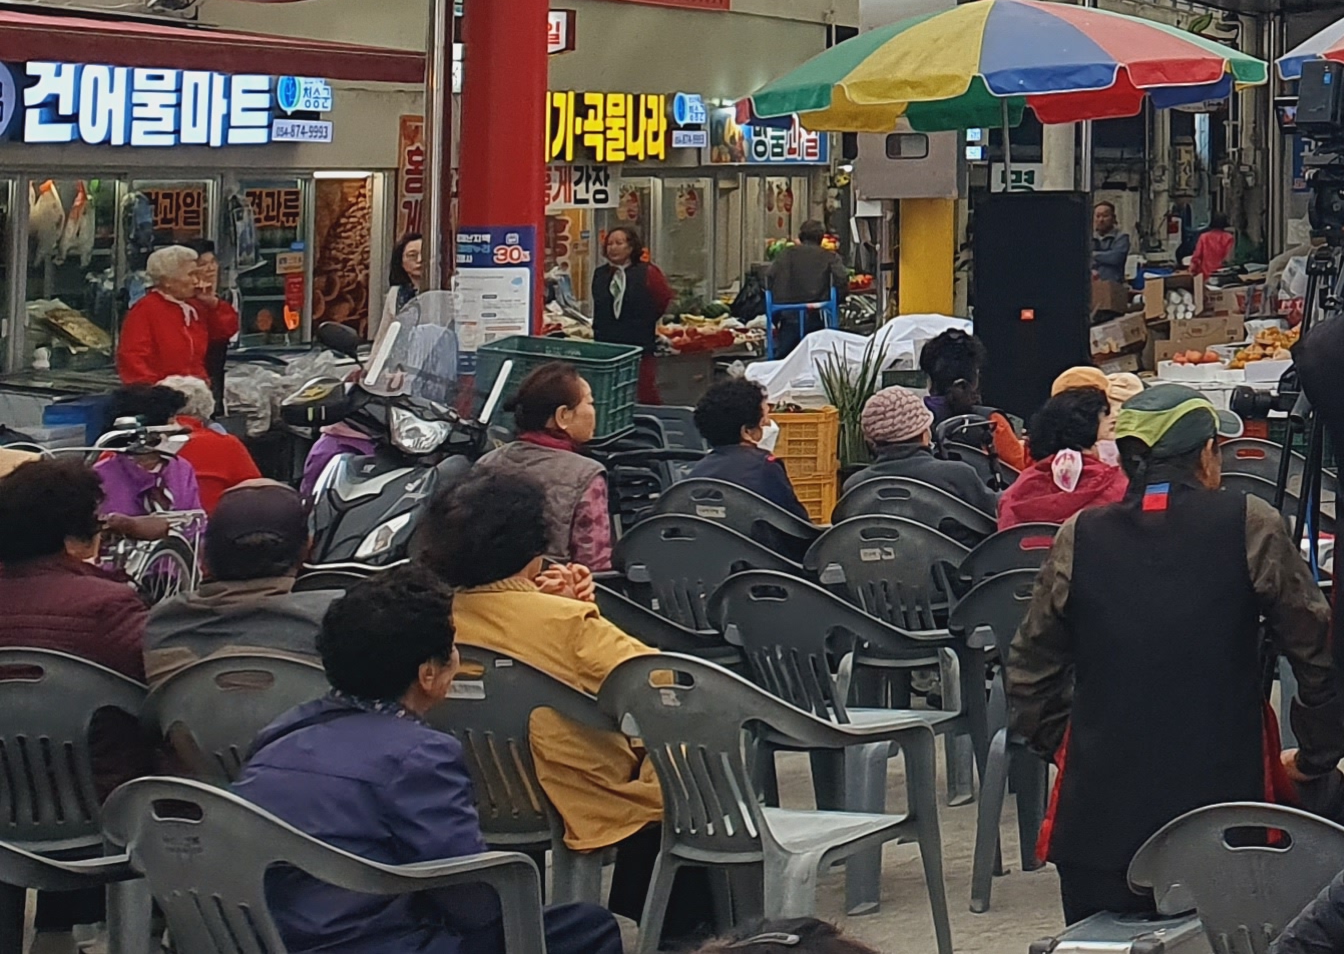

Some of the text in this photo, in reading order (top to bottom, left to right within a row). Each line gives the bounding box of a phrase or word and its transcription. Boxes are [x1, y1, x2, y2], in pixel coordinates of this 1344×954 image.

[24, 61, 273, 147] 건어물마트
[303, 87, 331, 109] 청송군
[276, 124, 329, 139] 054-874-9993
[545, 91, 667, 163] 기·곡물나라
